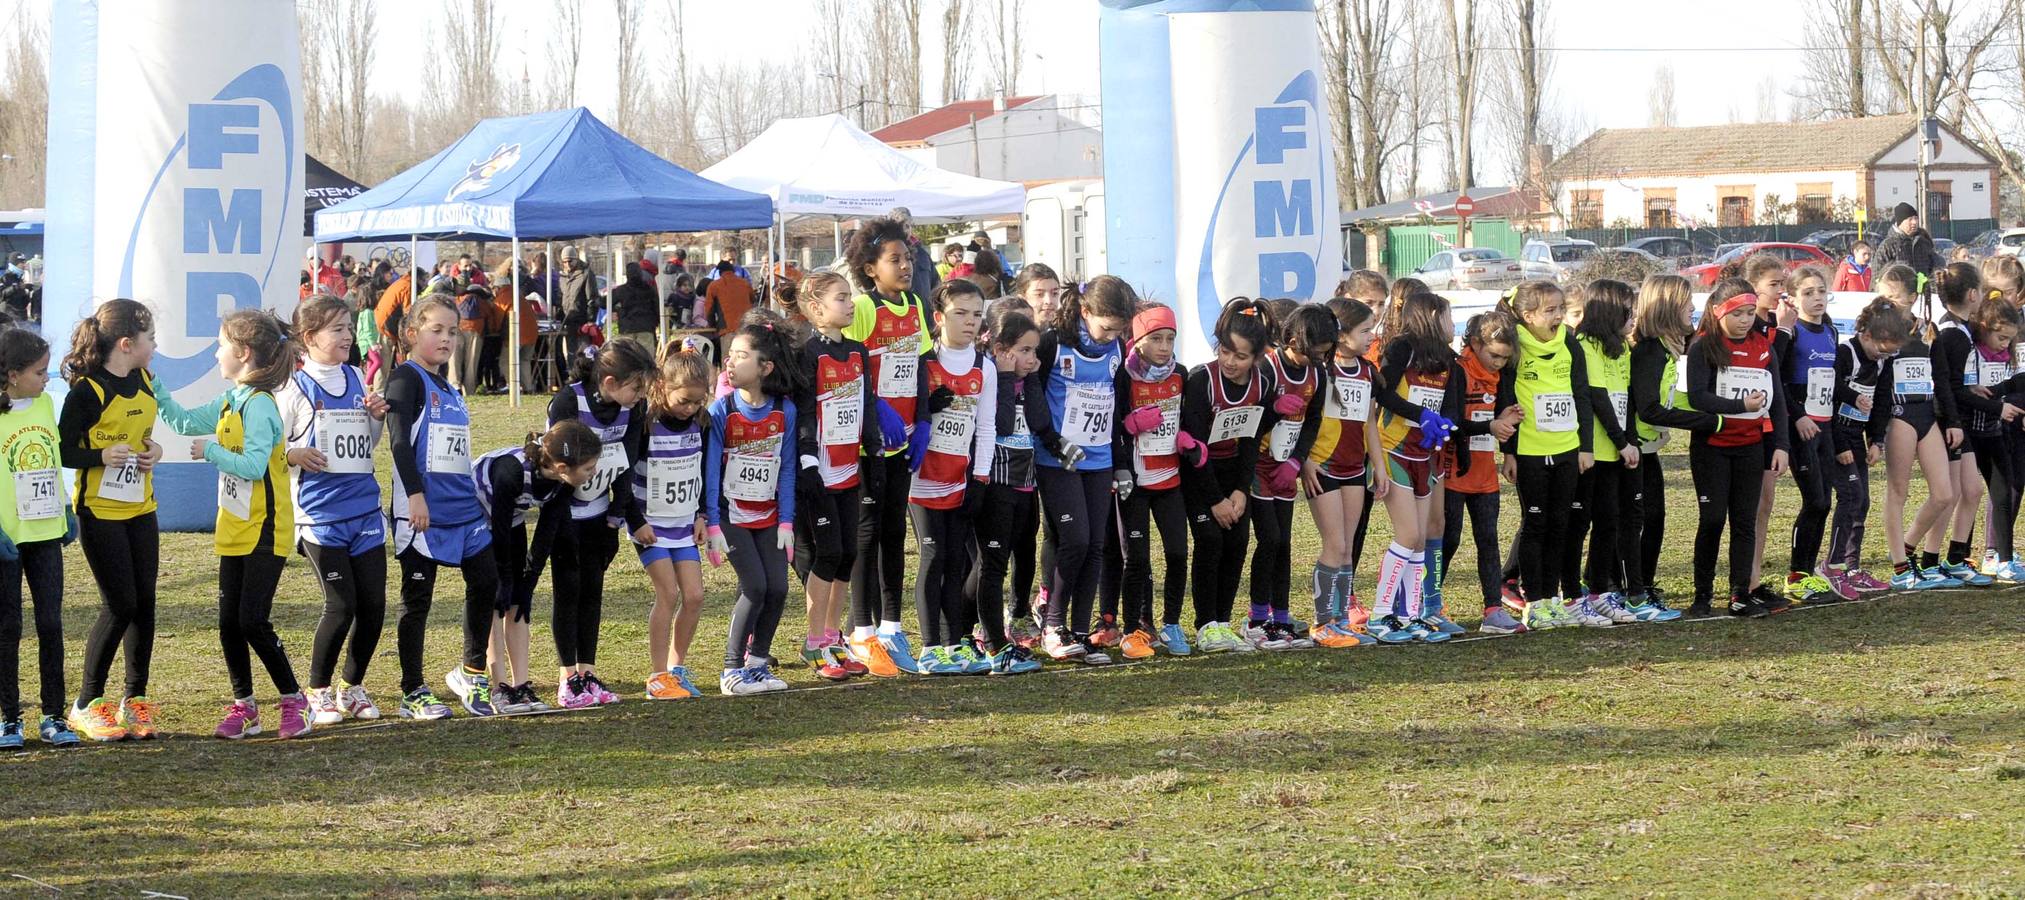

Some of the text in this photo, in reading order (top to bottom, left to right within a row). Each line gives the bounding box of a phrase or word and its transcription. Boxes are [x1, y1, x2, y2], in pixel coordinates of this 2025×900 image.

[305, 187, 361, 198] ISTEMA
[788, 194, 825, 204] FMD
[1253, 106, 1318, 301] FMD
[183, 103, 262, 338] FMD
[894, 364, 914, 379] 2557
[1906, 366, 1925, 378] 5294
[1343, 389, 1362, 403] 319
[1731, 387, 1768, 408] 703
[837, 409, 858, 425] 5967
[1545, 401, 1571, 417] 5497
[937, 419, 965, 437] 4990
[1083, 411, 1109, 433] 798
[1223, 413, 1248, 428] 6138
[1, 425, 56, 454] CLUB ATLETISMO
[334, 434, 372, 459] 6082
[447, 436, 469, 457] 743
[115, 464, 141, 484] 769
[739, 466, 769, 483] 4943
[665, 476, 700, 504] 5570
[1433, 549, 1443, 591] Kalenji
[1382, 559, 1404, 604] Kalenji
[1411, 565, 1423, 611] Kalenji
